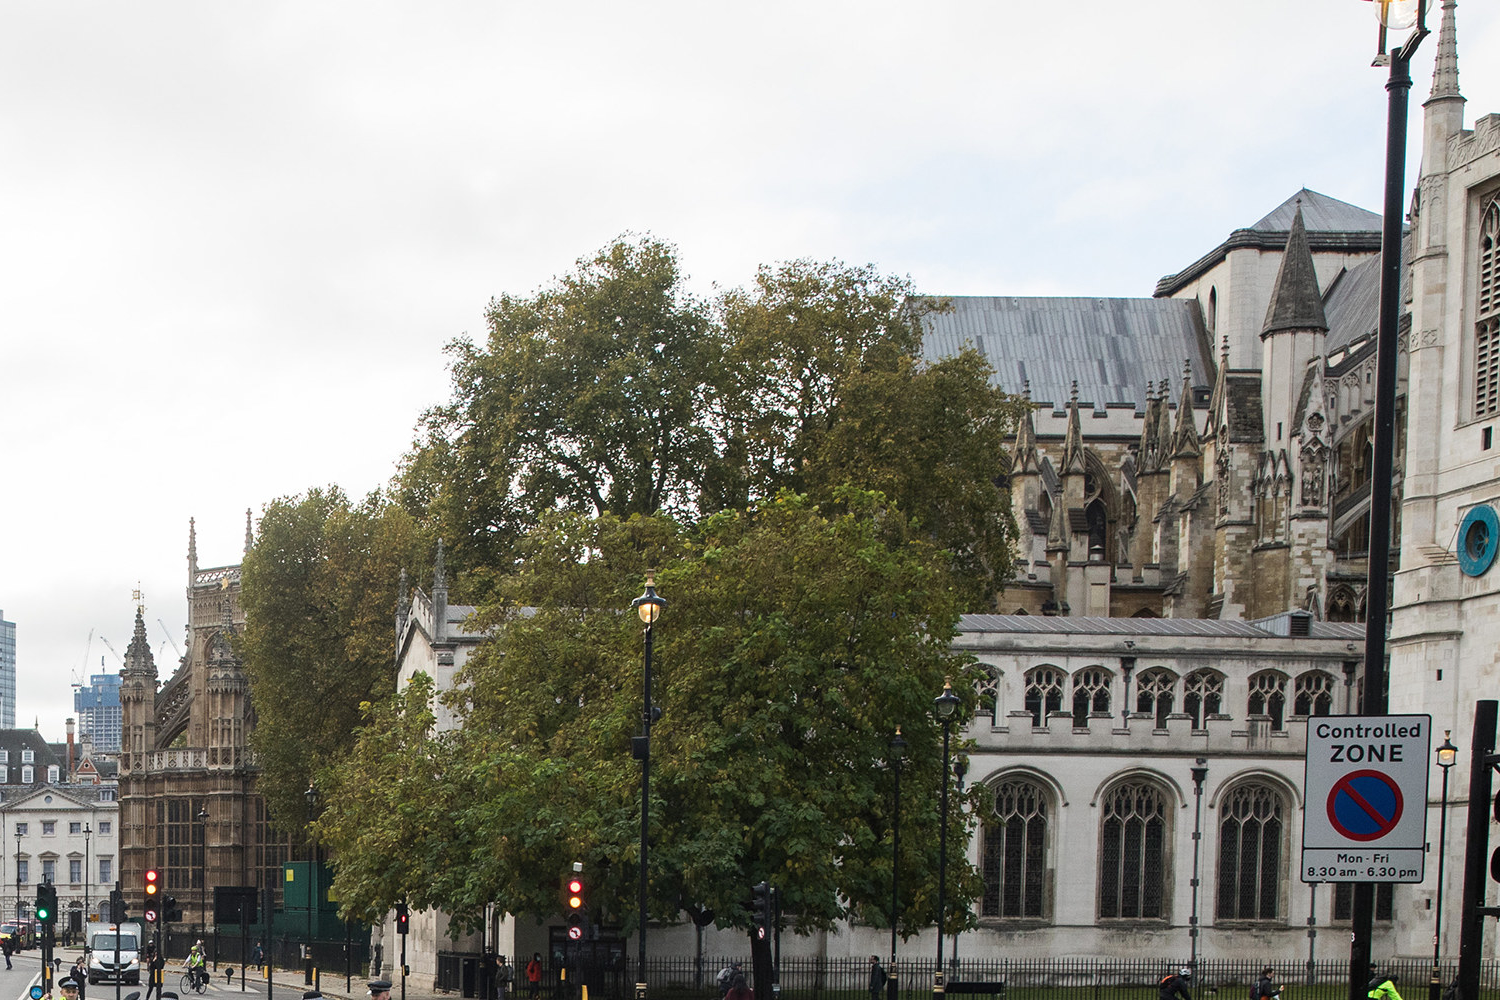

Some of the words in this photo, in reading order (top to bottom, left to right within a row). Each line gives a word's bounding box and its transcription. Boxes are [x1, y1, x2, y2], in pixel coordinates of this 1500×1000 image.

[1316, 723, 1421, 738] Controlled
[1330, 744, 1404, 763] ZONE
[1337, 854, 1363, 863] Mon
[1373, 854, 1389, 863] Fri
[1307, 867, 1337, 877] 8.30
[1339, 869, 1357, 877] am
[1367, 867, 1396, 877] 6.30
[1399, 869, 1418, 878] pm
